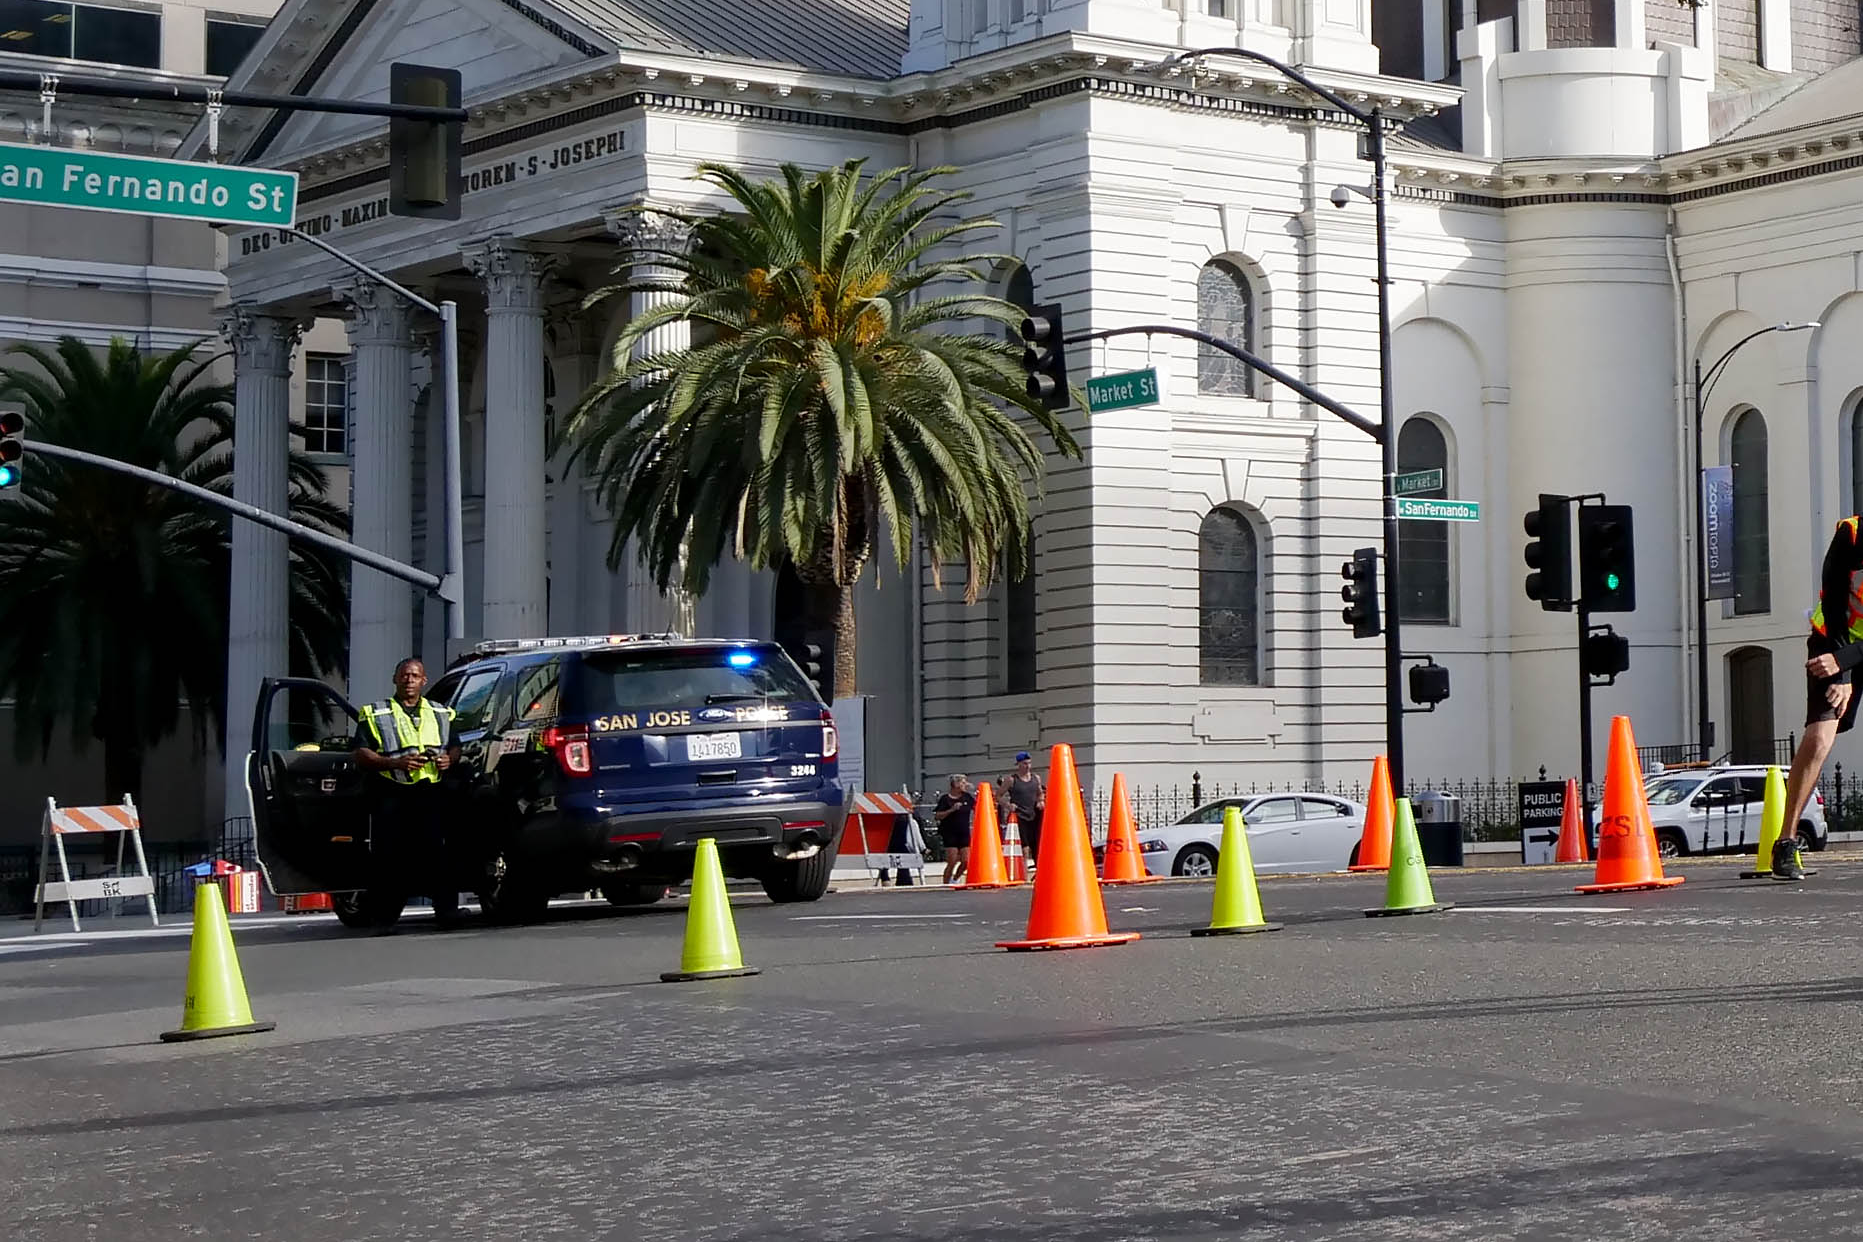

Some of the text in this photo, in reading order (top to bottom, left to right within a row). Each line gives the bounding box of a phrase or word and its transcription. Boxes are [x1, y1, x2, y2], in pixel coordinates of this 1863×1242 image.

[0, 164, 285, 212] an Fernando St
[342, 198, 389, 227] MAXIM
[550, 130, 625, 169] JOSEPHI
[1090, 377, 1155, 405] Market St
[1402, 475, 1431, 490] Market
[599, 714, 638, 731] SAN
[646, 710, 691, 727] JOSE
[1524, 793, 1561, 805] PUBLIC
[1524, 807, 1563, 818] PARKING
